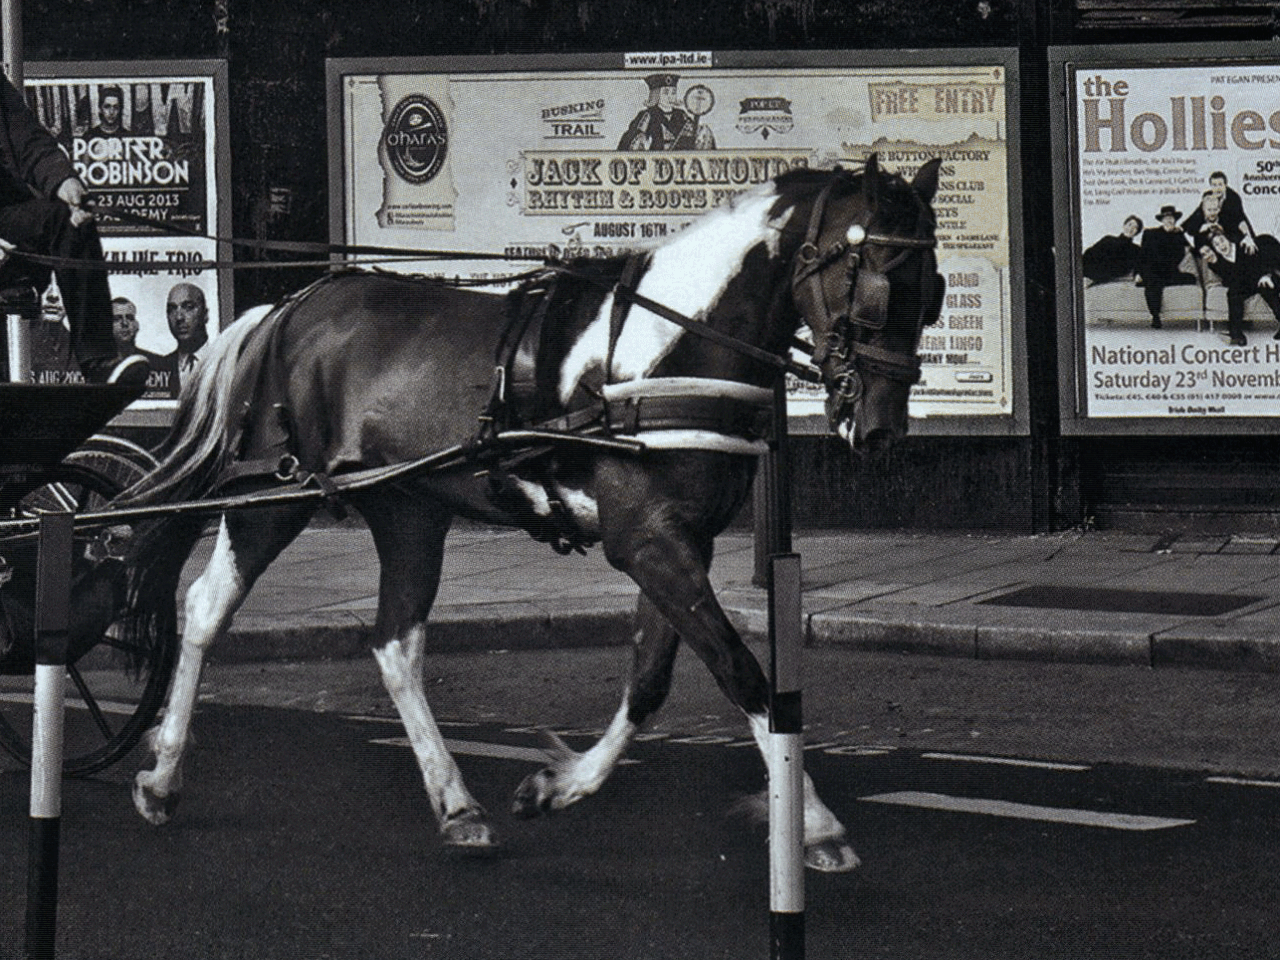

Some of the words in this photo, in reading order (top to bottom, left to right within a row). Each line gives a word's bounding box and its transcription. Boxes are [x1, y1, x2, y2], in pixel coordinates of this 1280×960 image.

[1083, 75, 1129, 97] the
[541, 99, 605, 119] BUSKING
[876, 88, 918, 114] FREE
[935, 87, 996, 114] ENTRY
[552, 123, 600, 136] TRAIL
[73, 137, 164, 161] PORTER
[888, 150, 935, 161] BUTTON
[73, 160, 189, 185] ROBINSON
[528, 158, 602, 186] JACK
[609, 158, 646, 186] OF
[956, 181, 984, 191] CLUB
[98, 195, 113, 207] 23
[116, 195, 145, 207] AUG
[148, 194, 179, 207] 2013
[528, 190, 614, 209] RHYTHM
[618, 189, 634, 209] &
[638, 188, 708, 209] ROOTS
[593, 222, 636, 238] AUGUST
[640, 223, 667, 238] 16TH
[948, 273, 979, 287] BAND
[946, 294, 981, 308] GLASS
[1092, 344, 1176, 365] National
[1181, 344, 1260, 365] Concert
[1094, 370, 1171, 392] Saturday
[1175, 369, 1208, 387] 23rd
